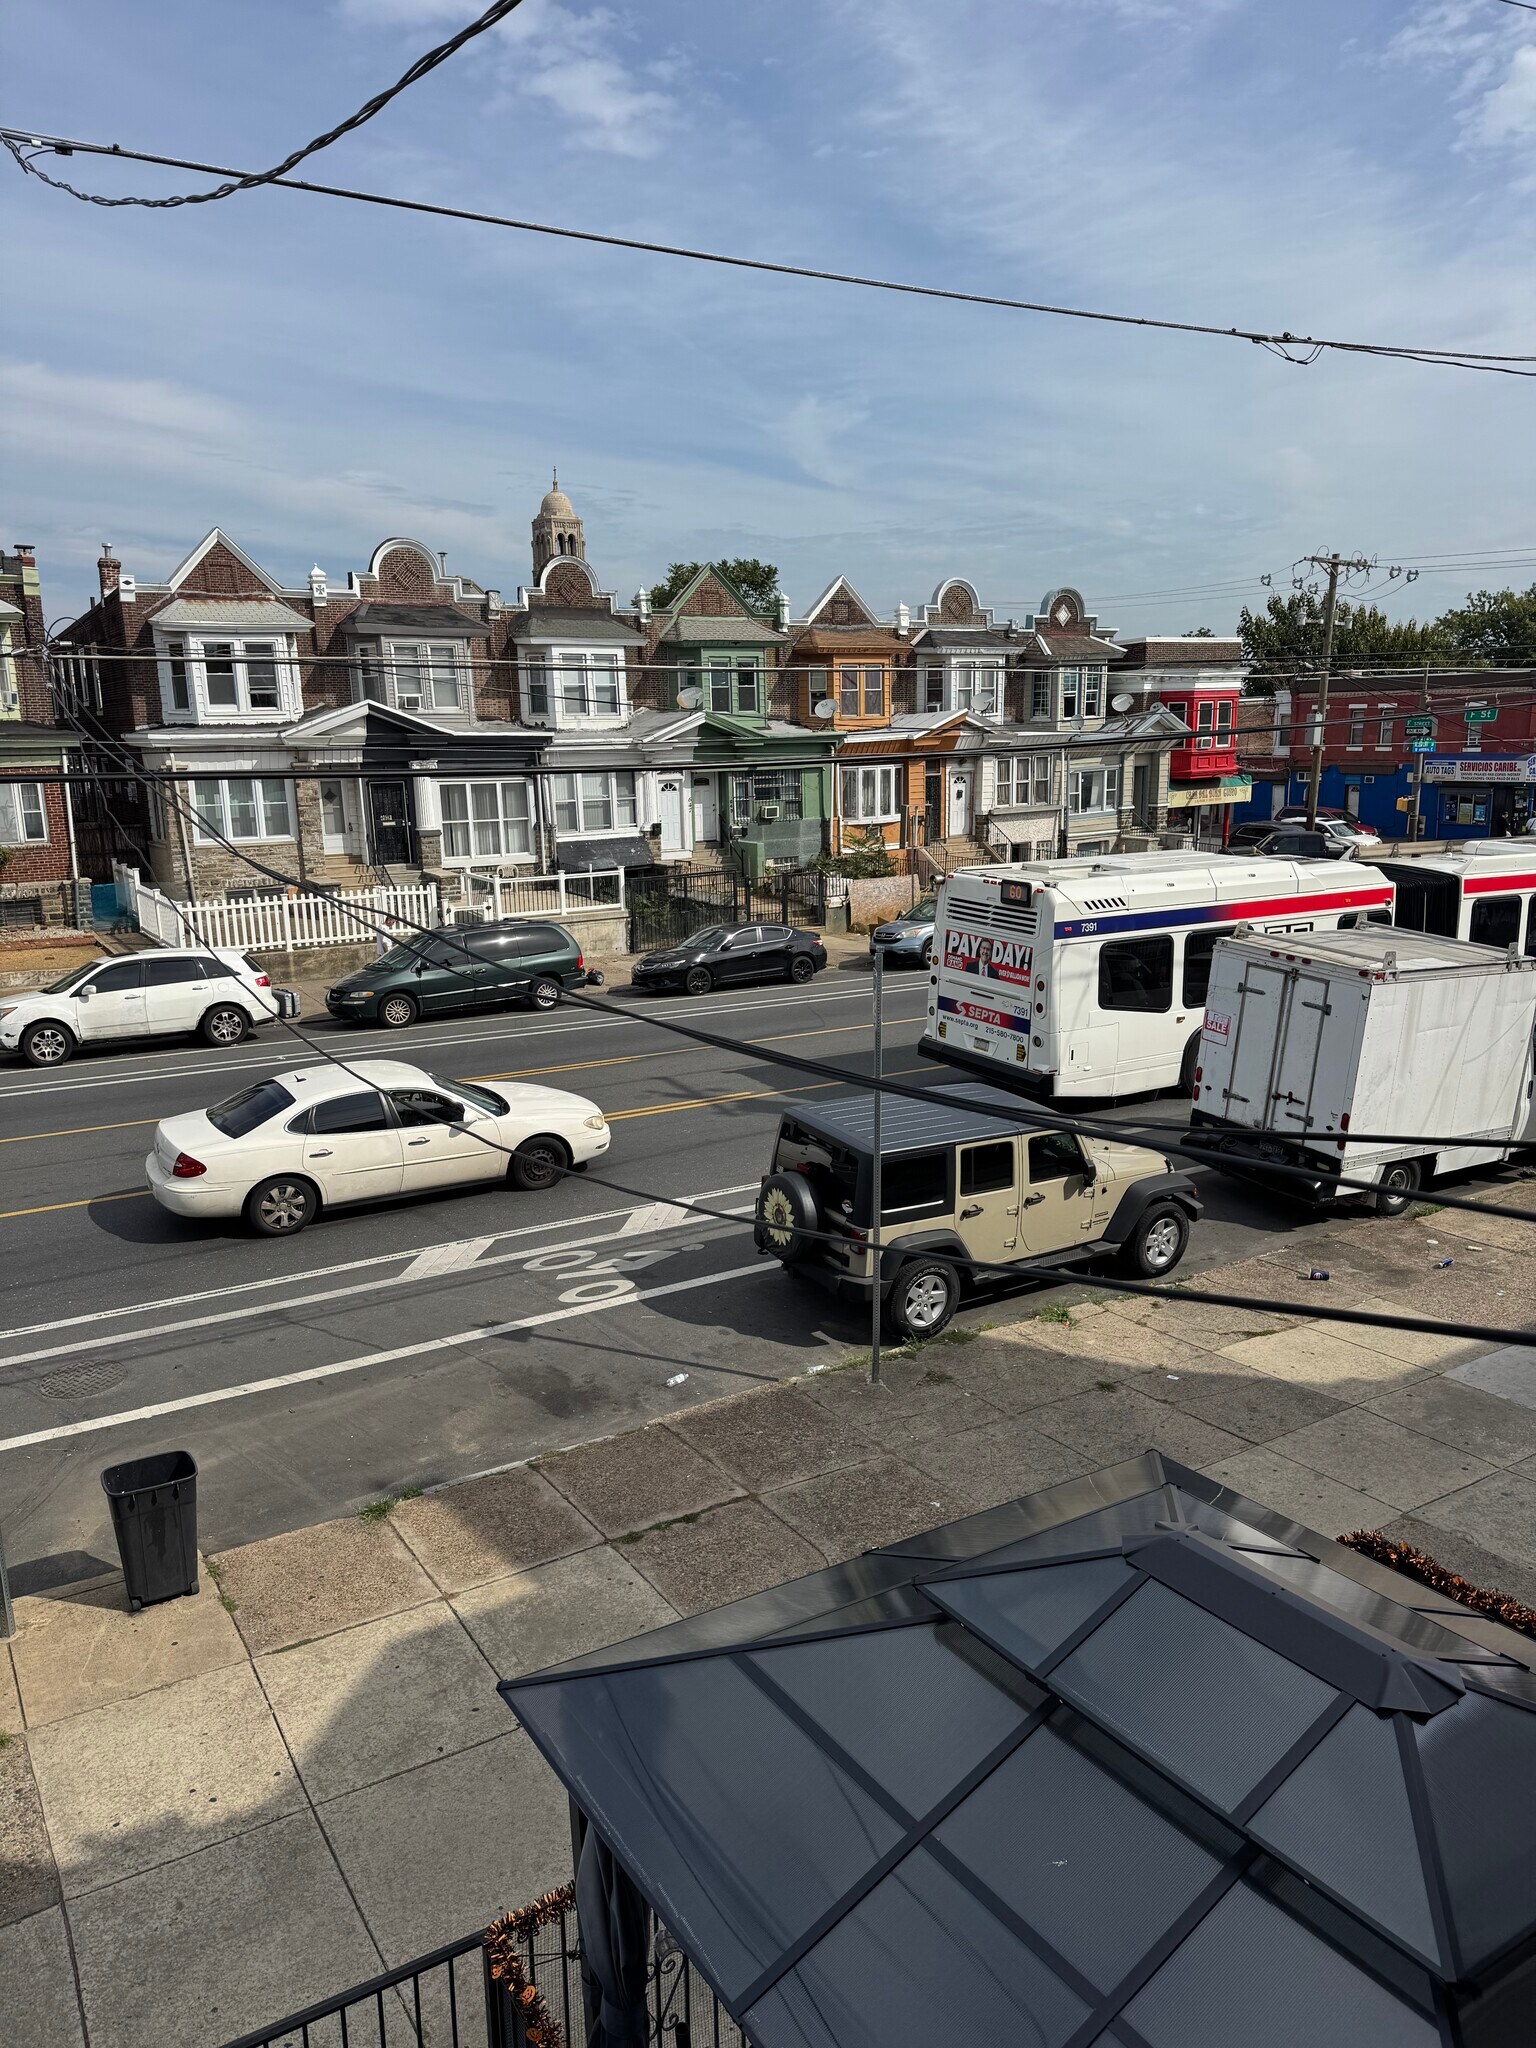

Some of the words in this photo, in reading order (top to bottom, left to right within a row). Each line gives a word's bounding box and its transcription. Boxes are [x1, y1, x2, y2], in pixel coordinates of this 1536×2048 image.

[1480, 710, 1491, 718] St
[1425, 766, 1440, 775] AUTO
[1441, 766, 1455, 775] TAGS
[1459, 761, 1493, 772] SERVICIOS
[1493, 761, 1518, 772] CARIBE
[1009, 884, 1022, 900] 60
[1080, 922, 1097, 933] 7391
[947, 930, 982, 959] PAY
[991, 939, 1031, 971] DAY!
[968, 1005, 1001, 1025] SEPTA
[1013, 1005, 1028, 1017] 7391
[942, 1014, 979, 1031] www.septa.org
[1207, 1020, 1227, 1034] SALE
[985, 1026, 1024, 1043] 215-580-7800
